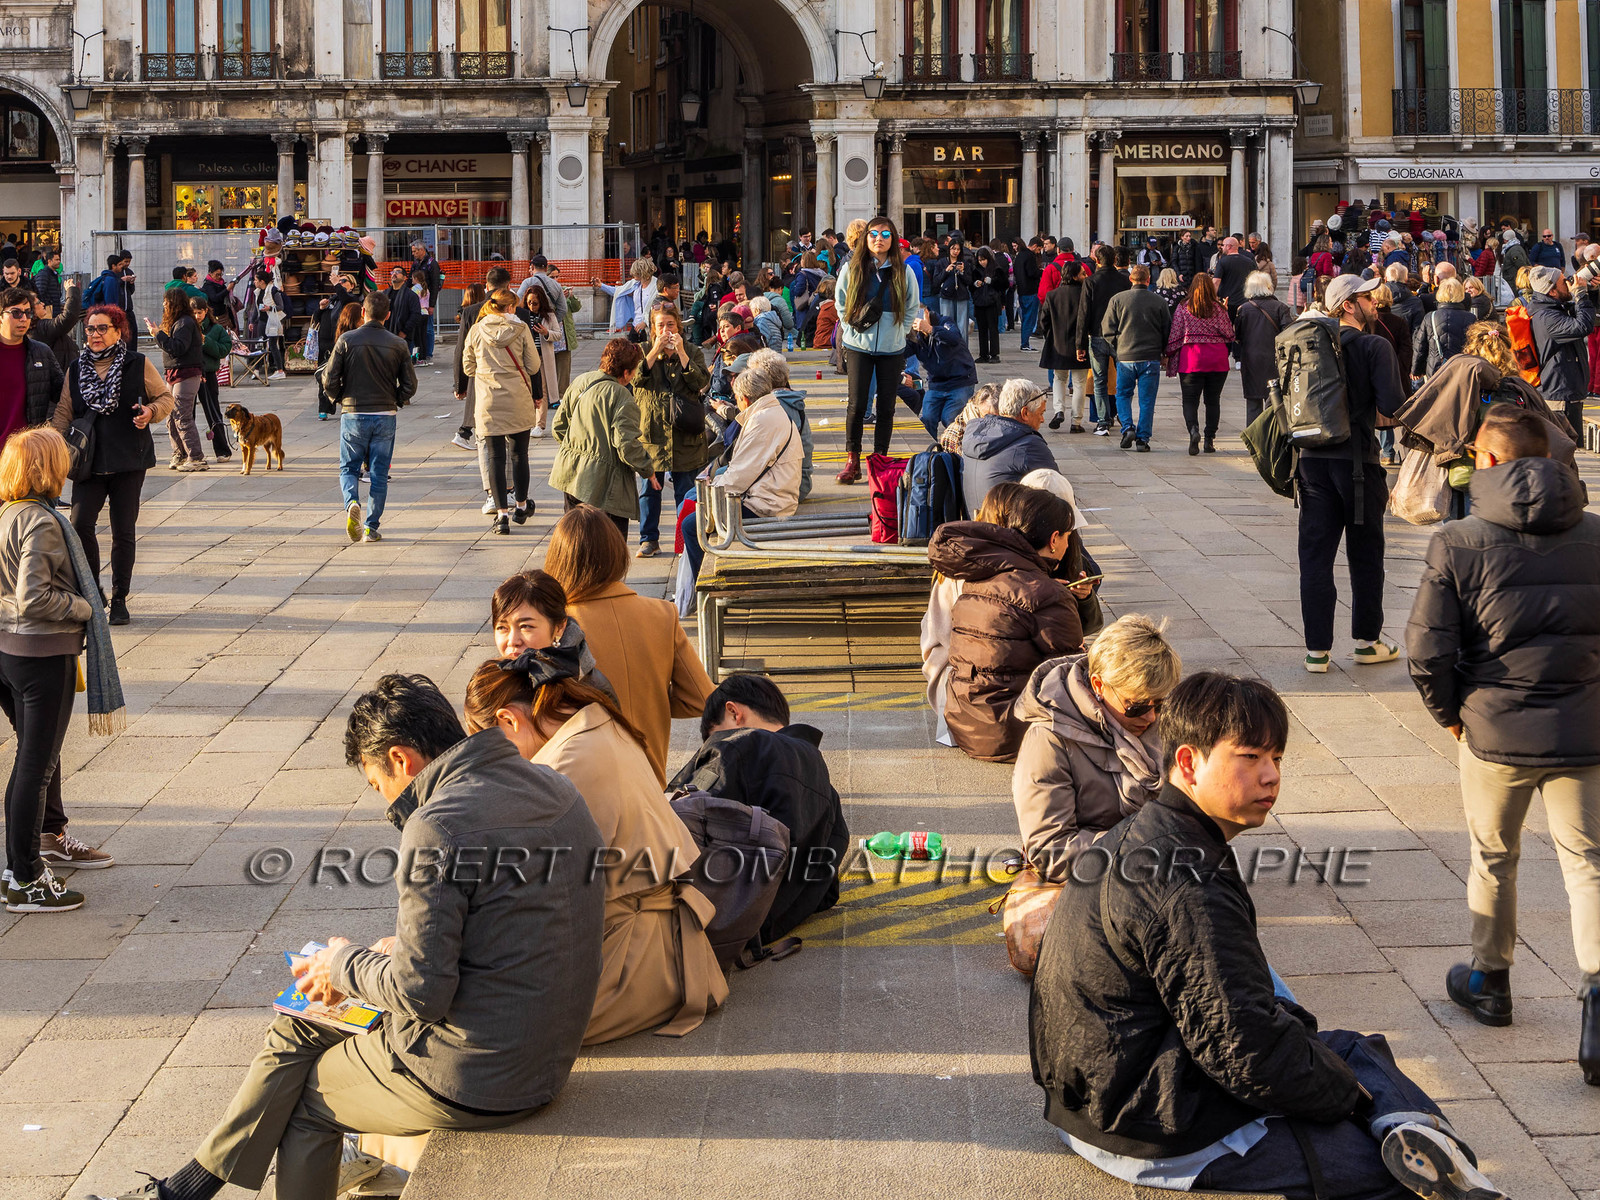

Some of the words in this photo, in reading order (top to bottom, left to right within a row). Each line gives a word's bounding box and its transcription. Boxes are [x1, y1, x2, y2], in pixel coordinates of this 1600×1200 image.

[933, 146, 984, 161] BAR
[1113, 144, 1223, 159] AMERICANO
[242, 162, 276, 173] Galler
[405, 159, 477, 172] CHANGE
[1388, 168, 1464, 179] GIOBAGNARA
[388, 200, 468, 216] CHANGE
[1139, 218, 1154, 227] ICE
[1161, 218, 1193, 228] CREAM
